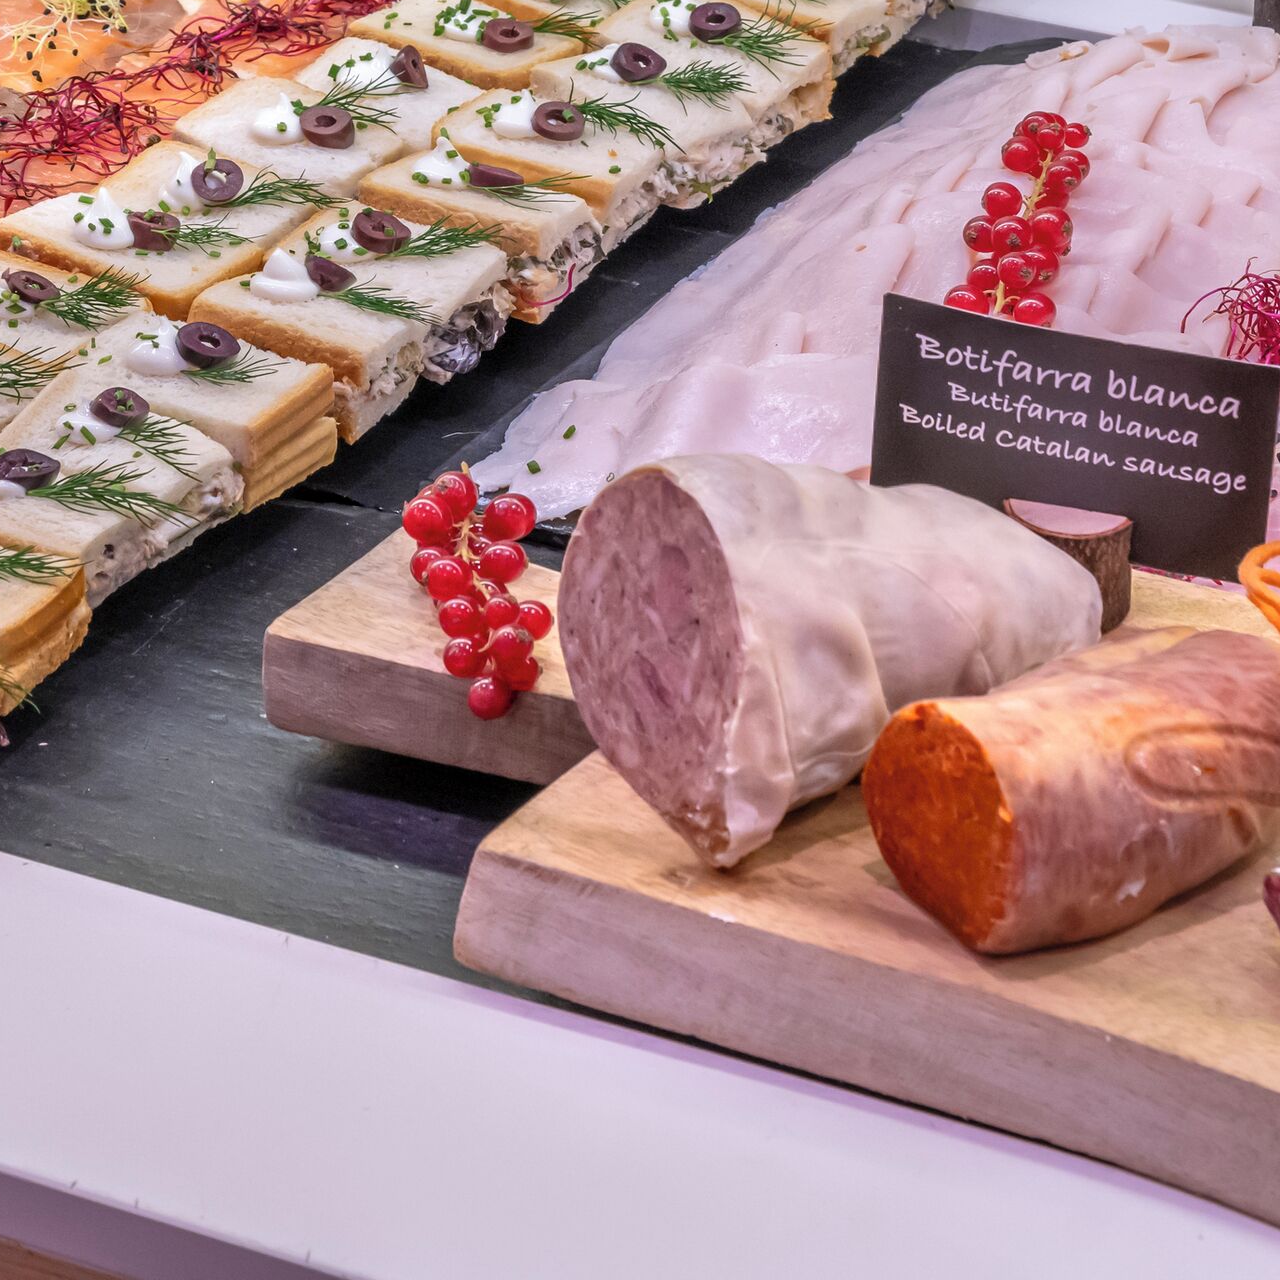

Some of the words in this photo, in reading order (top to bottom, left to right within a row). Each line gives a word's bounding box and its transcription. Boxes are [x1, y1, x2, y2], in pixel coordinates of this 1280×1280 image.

[916, 333, 1091, 394] Botifarra
[1107, 369, 1241, 419] blanca
[948, 381, 1086, 428] Butifarra
[1098, 409, 1199, 448] blanca
[898, 403, 986, 443] Boiled
[995, 429, 1116, 467] Catalan
[1122, 456, 1246, 495] sausage
